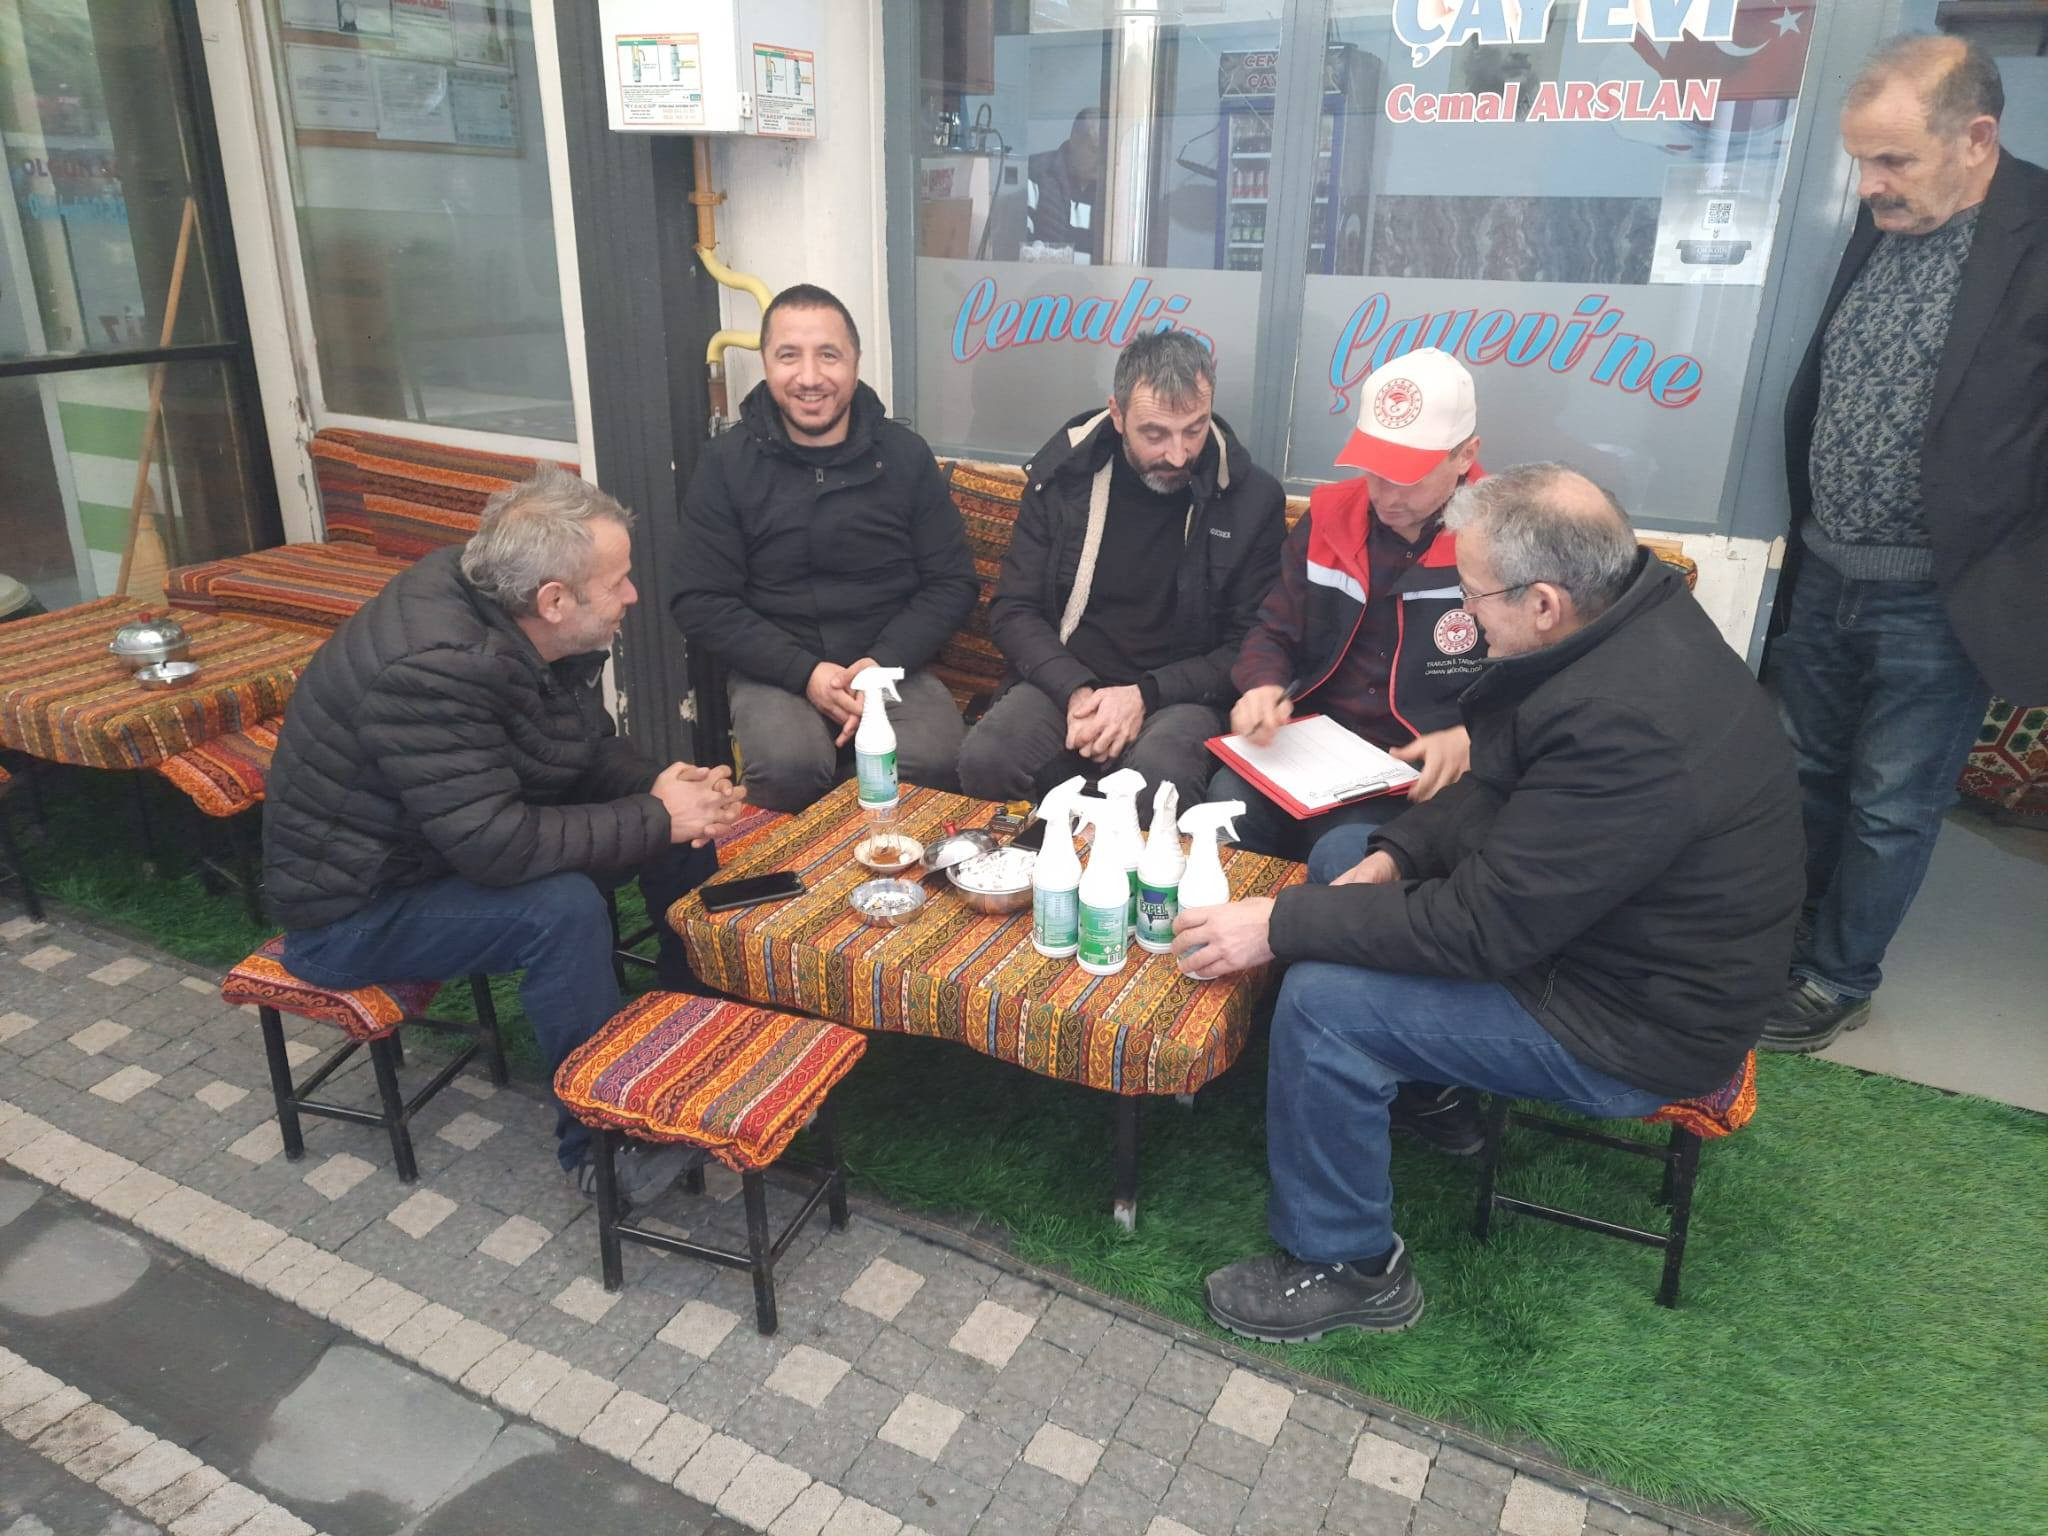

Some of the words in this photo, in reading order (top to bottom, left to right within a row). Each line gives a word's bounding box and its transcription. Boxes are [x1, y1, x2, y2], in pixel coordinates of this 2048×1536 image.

[1392, 0, 1554, 68] ÇAY
[1385, 84, 1520, 123] Cemal
[1525, 79, 1722, 121] ARSLAN
